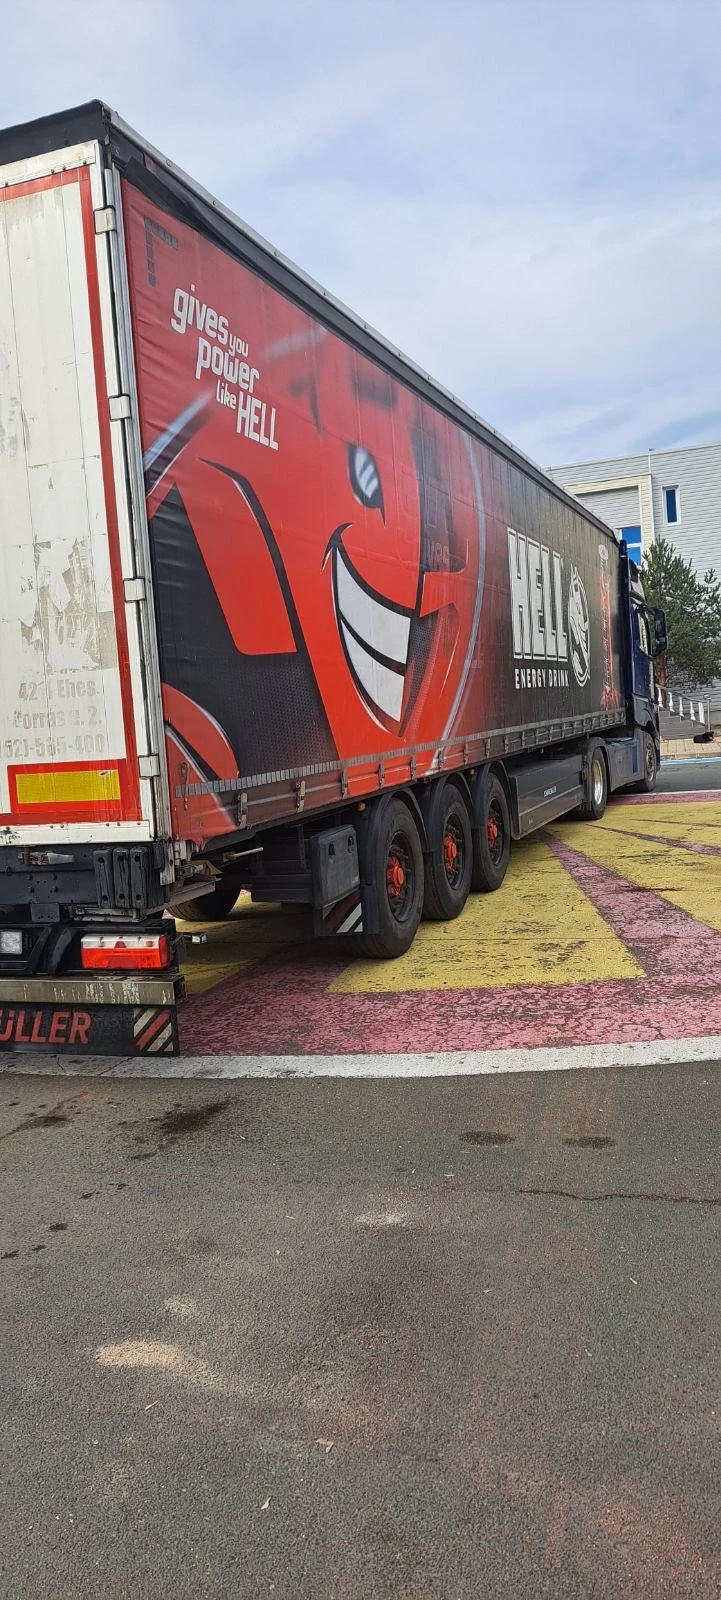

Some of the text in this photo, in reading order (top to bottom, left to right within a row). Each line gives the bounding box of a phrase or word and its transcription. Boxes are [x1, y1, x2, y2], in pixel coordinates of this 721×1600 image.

[171, 284, 249, 358] gives you
[195, 336, 259, 393] power
[216, 380, 279, 450] like HELL
[507, 527, 568, 662] HELL
[515, 668, 569, 689] ENERGY DRINK
